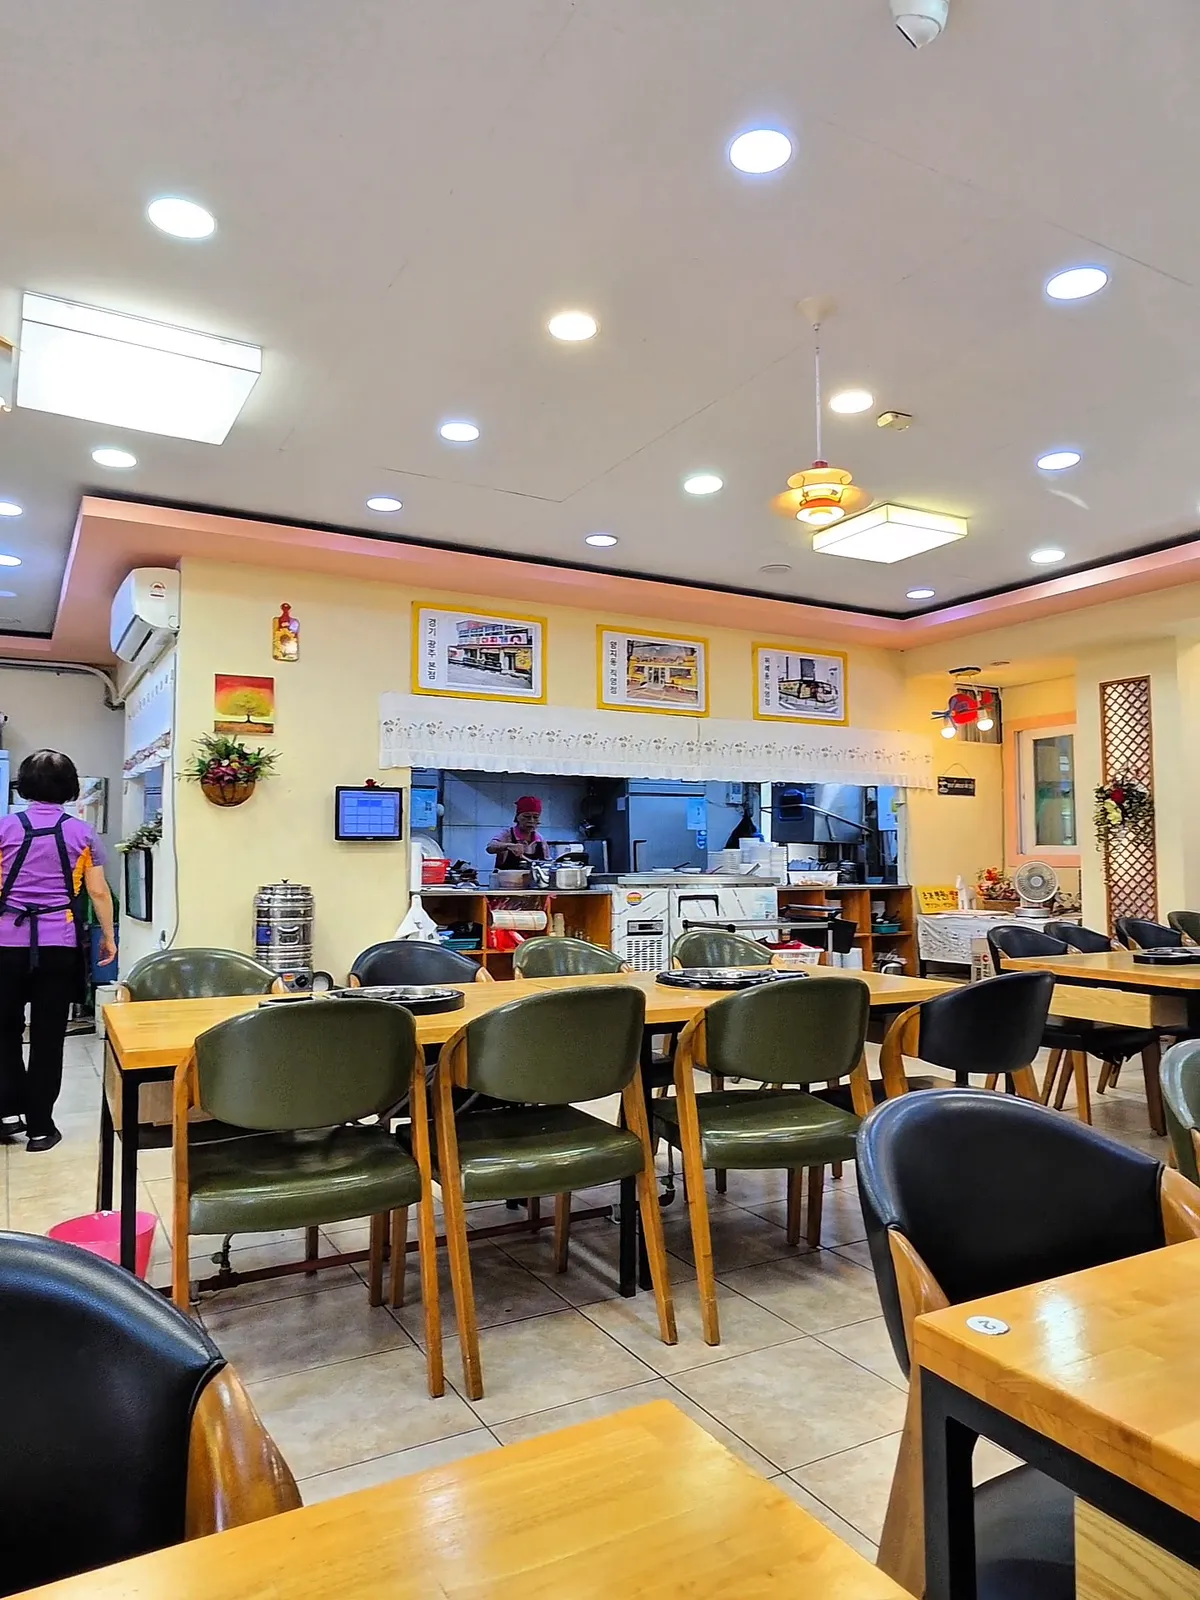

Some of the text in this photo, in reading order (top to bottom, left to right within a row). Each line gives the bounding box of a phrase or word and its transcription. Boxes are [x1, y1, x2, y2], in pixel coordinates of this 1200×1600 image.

[427, 618, 437, 680] 경기 광주 본점
[609, 669, 618, 695] 직영점
